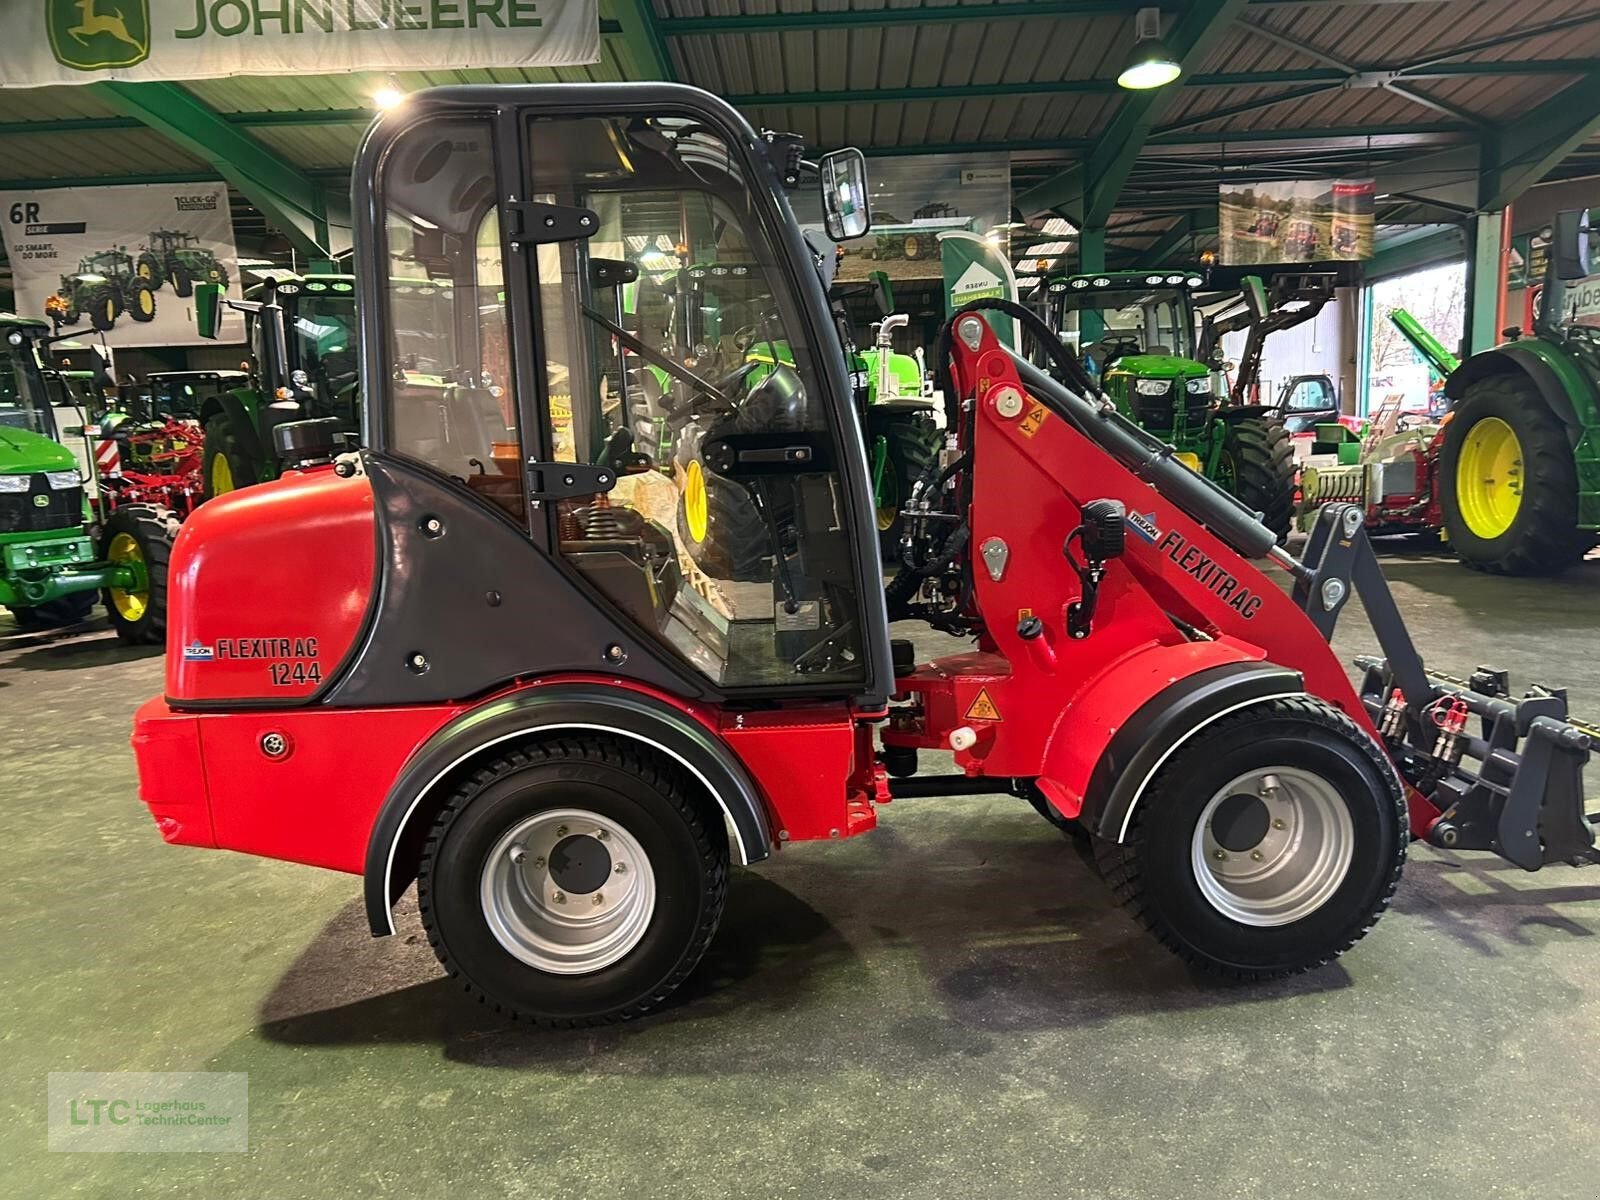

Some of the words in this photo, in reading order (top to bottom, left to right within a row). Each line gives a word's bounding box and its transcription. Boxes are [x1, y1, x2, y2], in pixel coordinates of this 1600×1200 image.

[174, 0, 333, 39] JOHN
[350, 0, 542, 31] DEERE
[10, 202, 40, 225] 6R
[35, 251, 58, 259] MORE
[1130, 512, 1159, 538] TREJON
[1159, 530, 1262, 619] FLEXITRAC
[217, 638, 318, 658] FLEXITRAC
[268, 662, 322, 685] 1244
